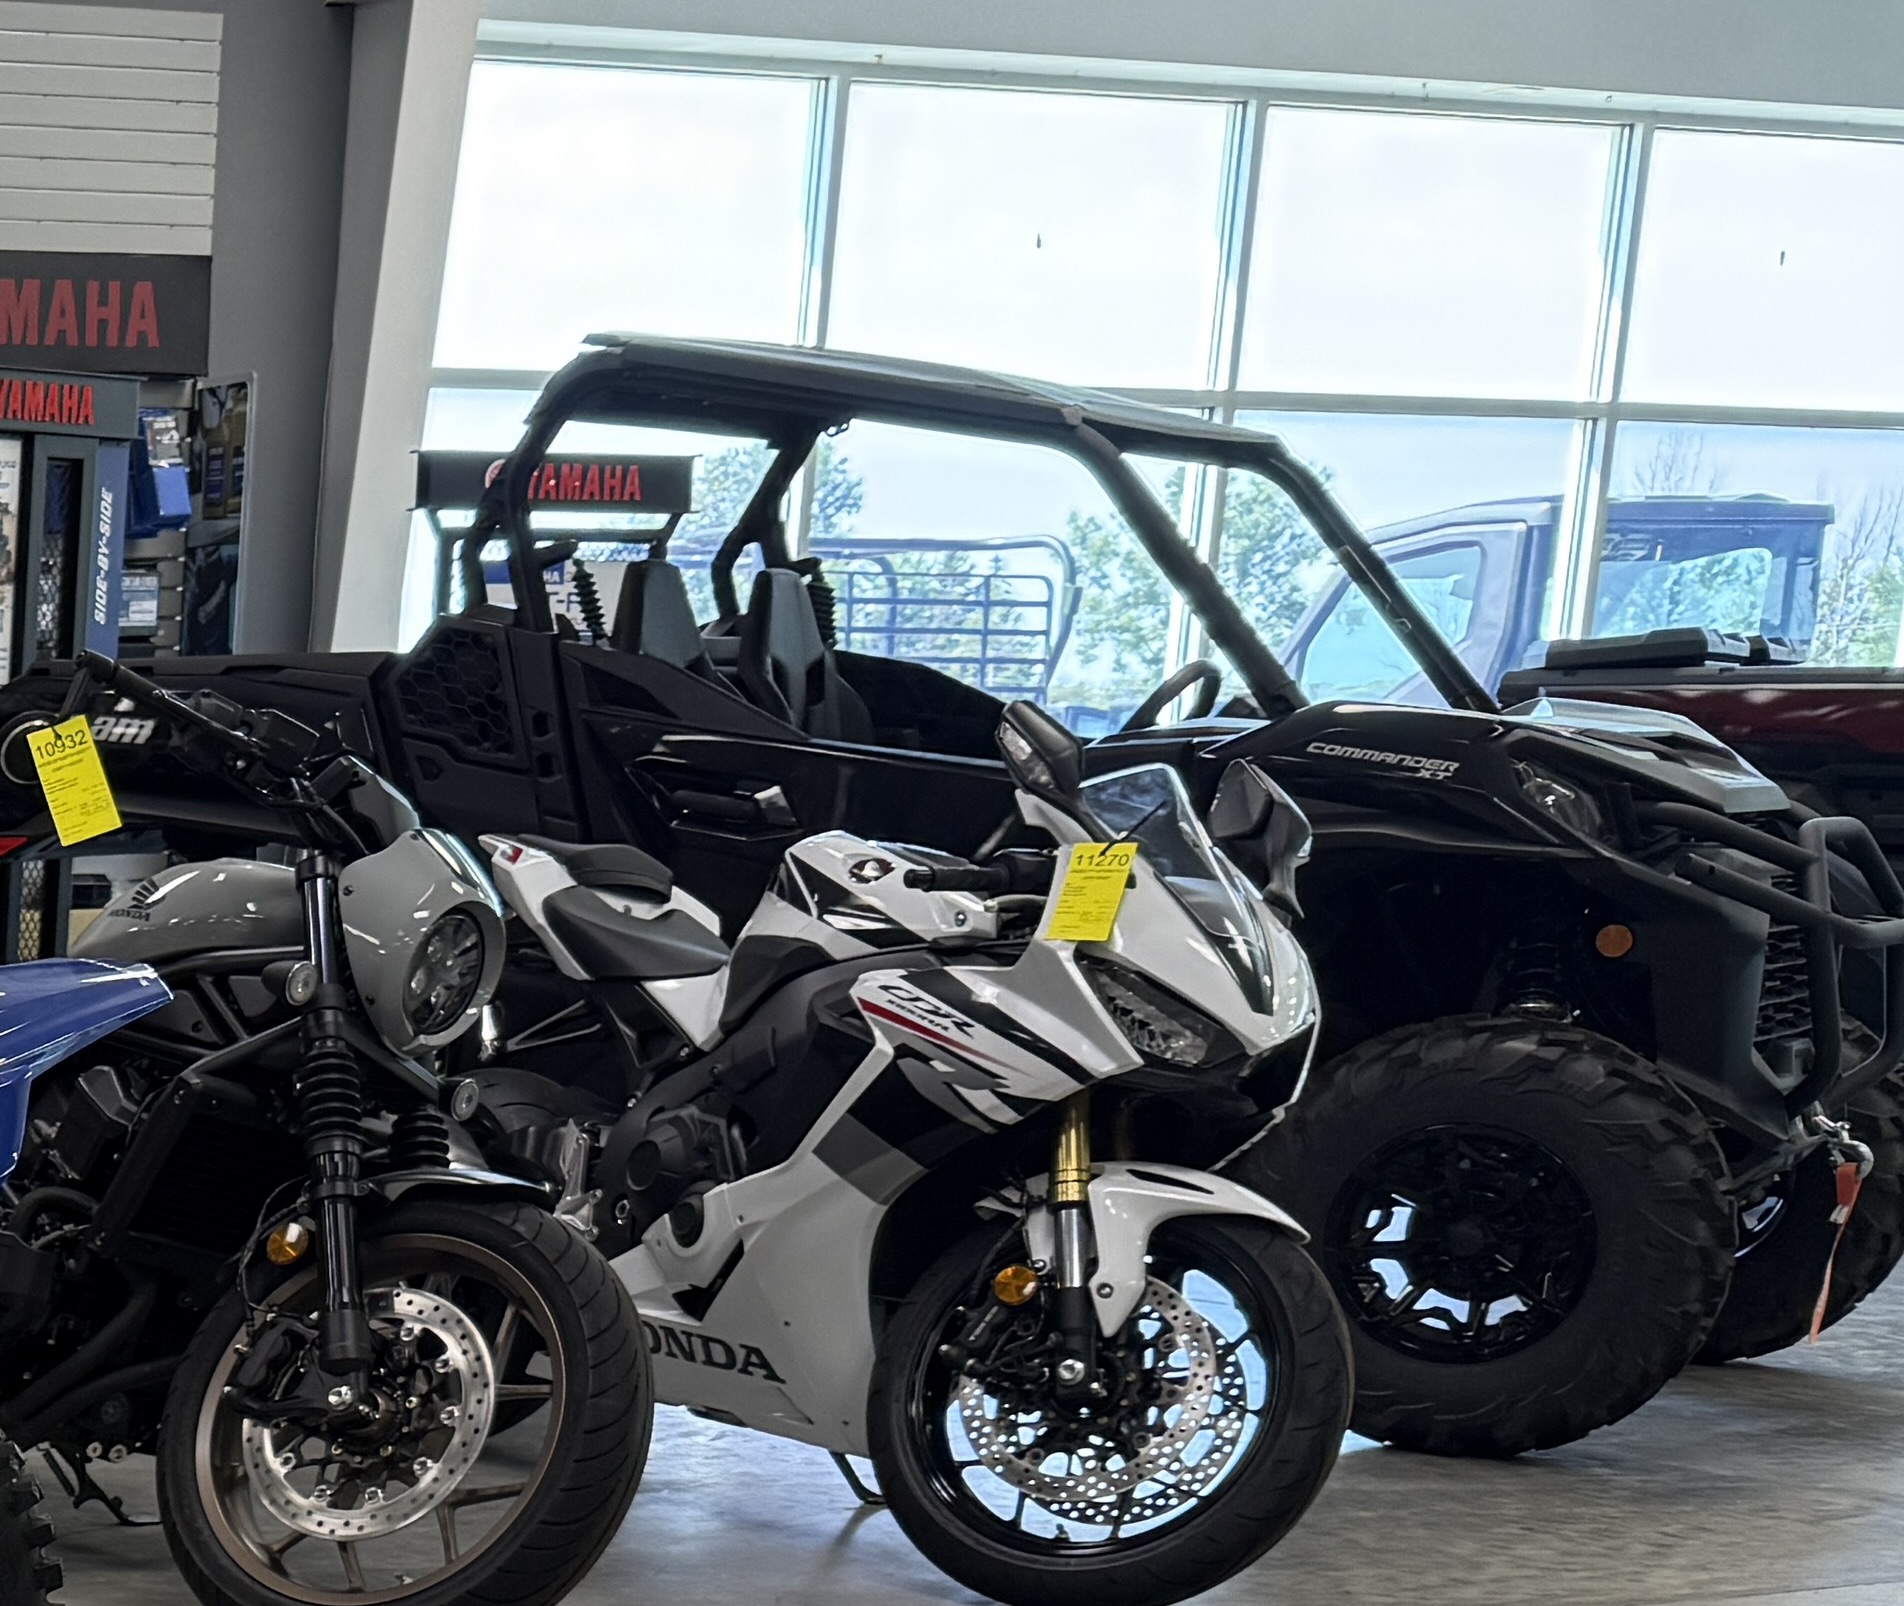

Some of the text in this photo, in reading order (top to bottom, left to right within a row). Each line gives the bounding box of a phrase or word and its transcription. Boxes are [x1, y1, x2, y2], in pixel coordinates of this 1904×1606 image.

[94, 486, 113, 625] SIDE-BY-SIDE
[36, 729, 88, 759] 10932
[1306, 742, 1460, 772] COMMANDER
[1075, 853, 1130, 867] 11270
[641, 1320, 786, 1385] ONDA
